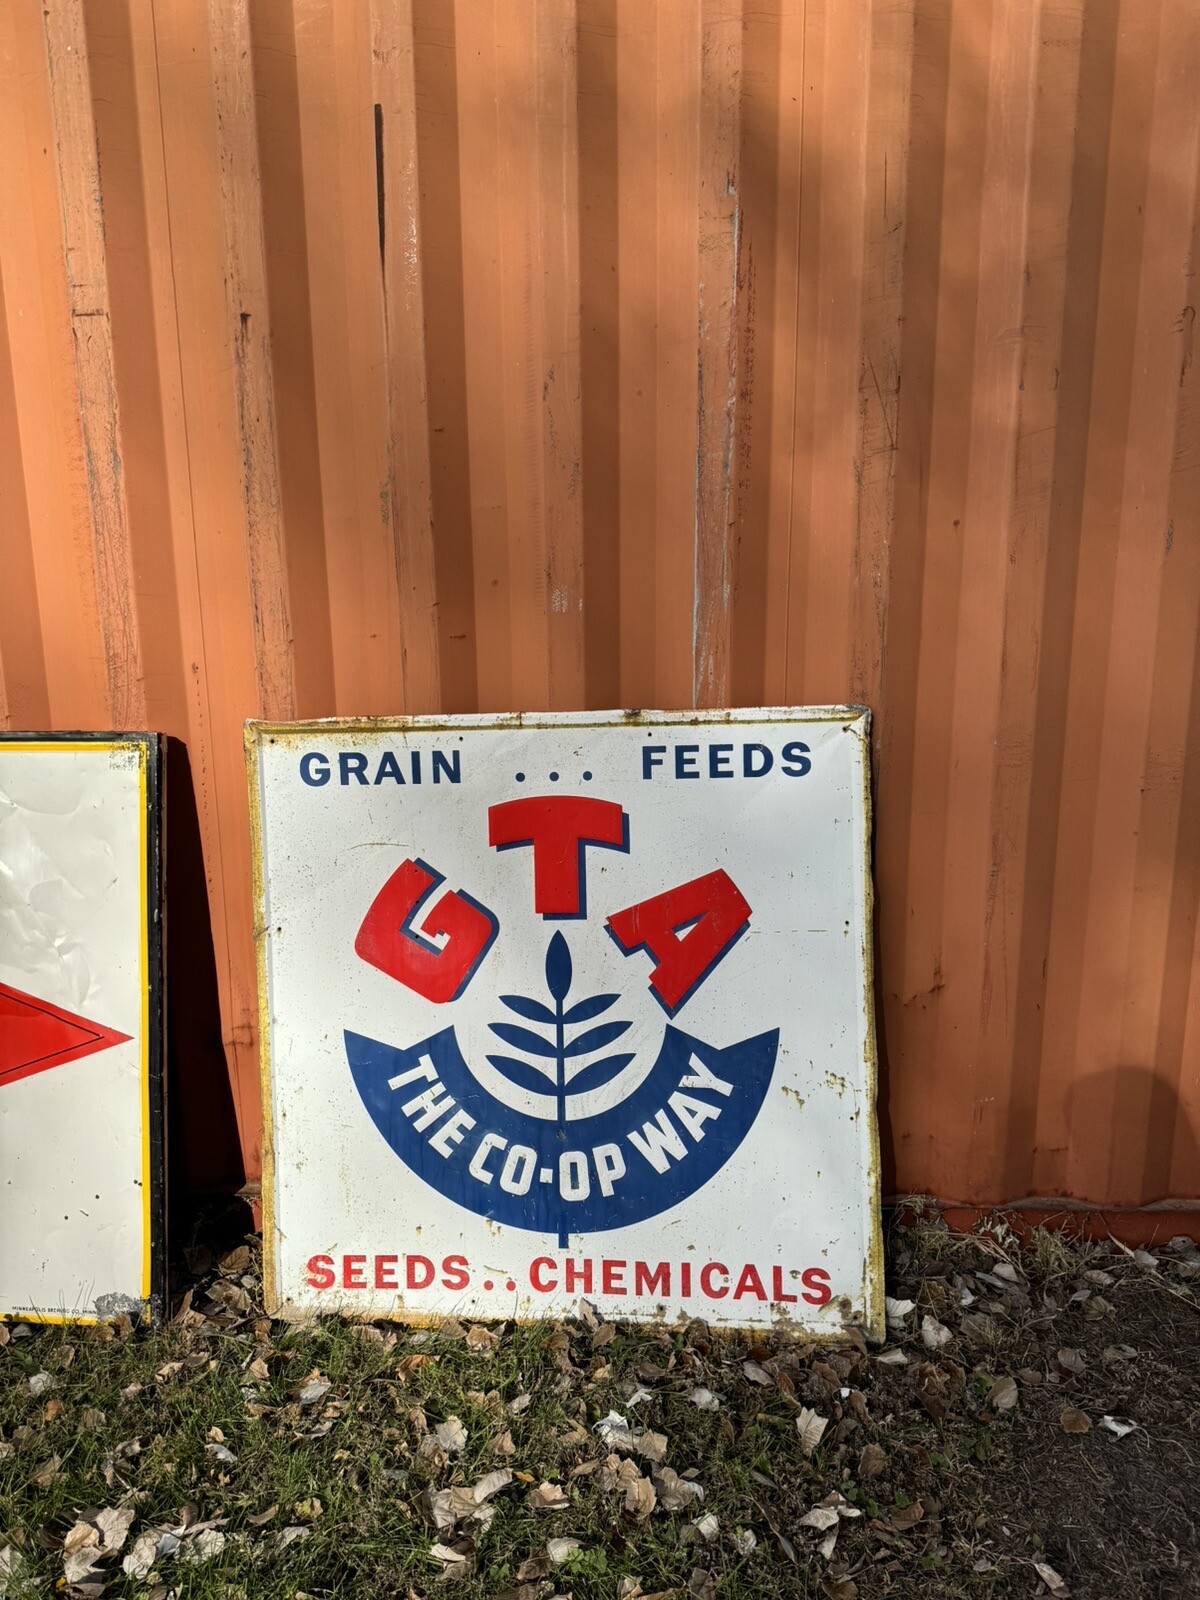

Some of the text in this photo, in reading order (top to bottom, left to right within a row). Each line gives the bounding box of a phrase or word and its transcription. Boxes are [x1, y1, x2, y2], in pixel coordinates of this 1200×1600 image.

[299, 750, 461, 787] GRAIN
[643, 742, 811, 780] FEEDS
[354, 795, 753, 1019] GTA
[387, 1054, 477, 1159] THE
[627, 1053, 735, 1175] WAY
